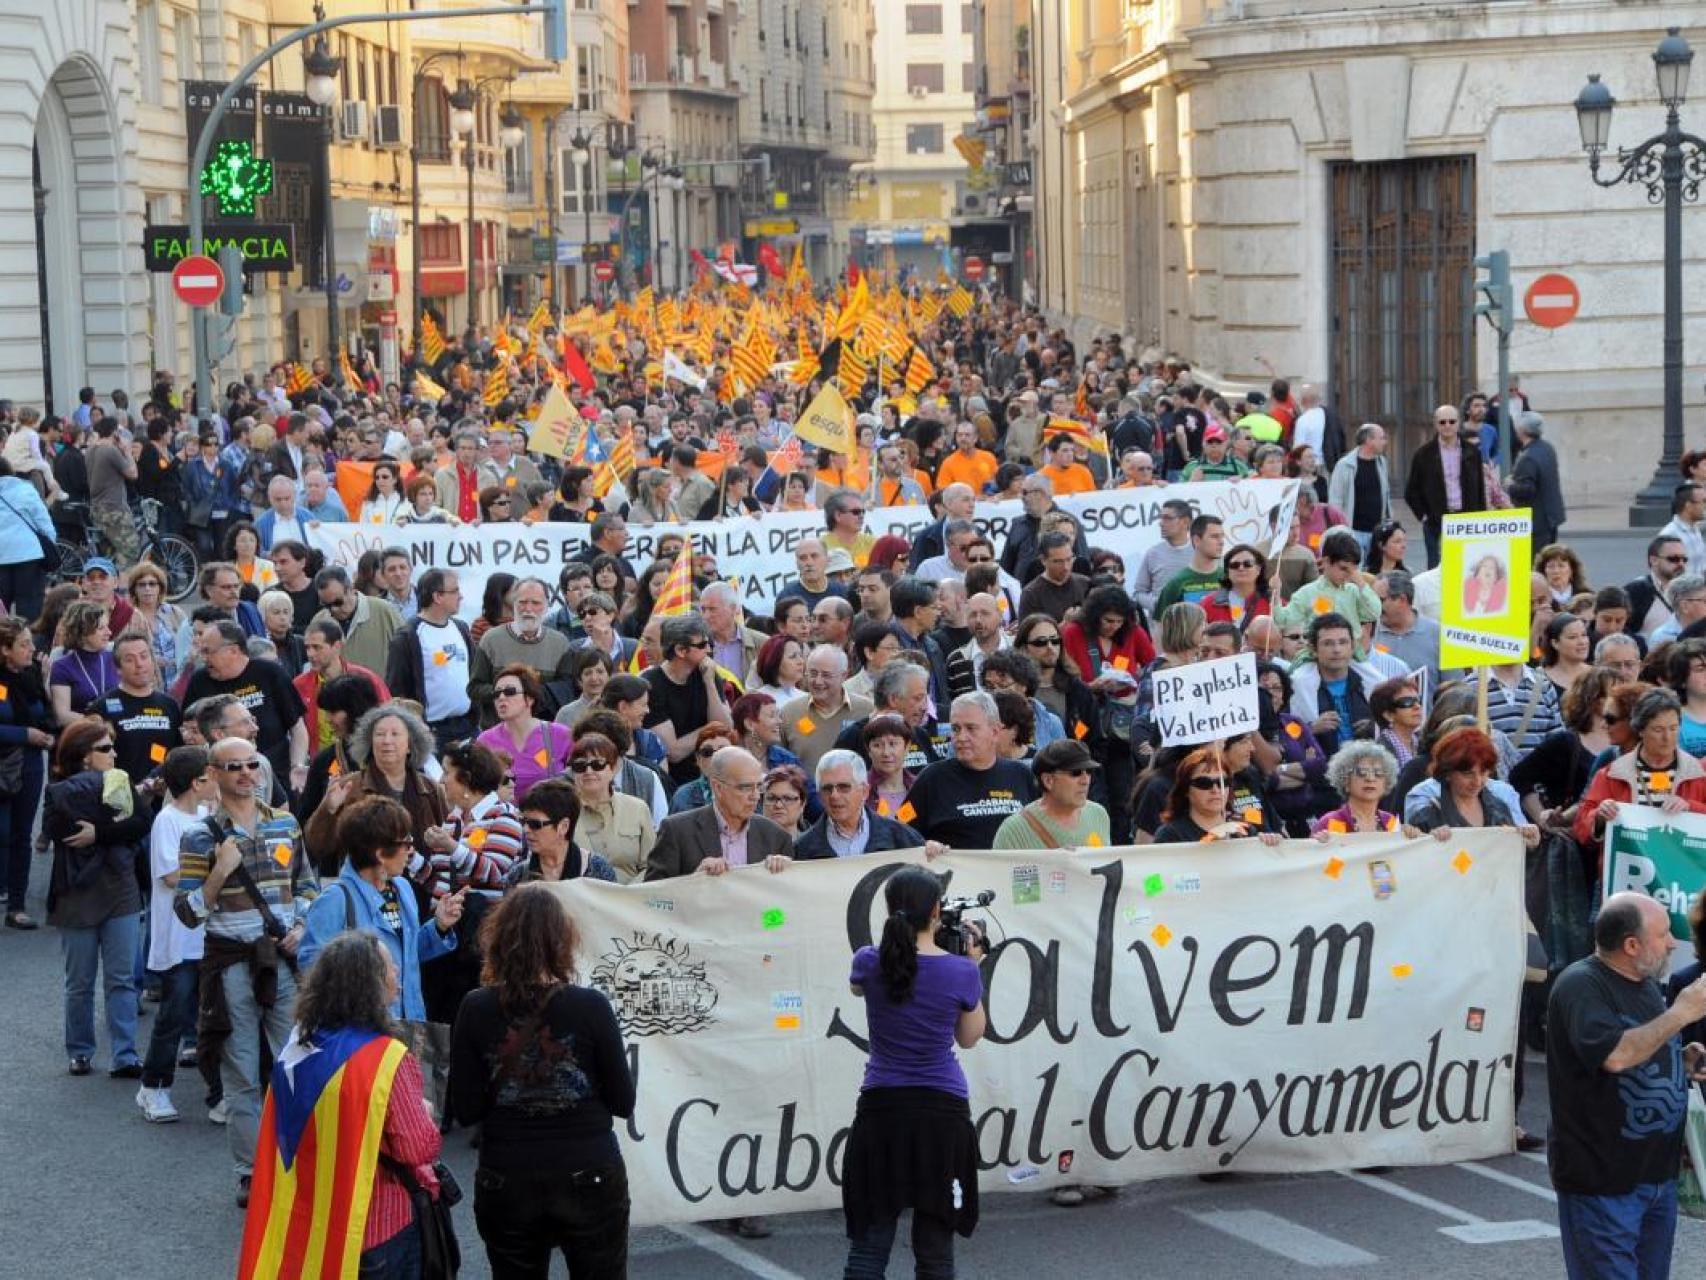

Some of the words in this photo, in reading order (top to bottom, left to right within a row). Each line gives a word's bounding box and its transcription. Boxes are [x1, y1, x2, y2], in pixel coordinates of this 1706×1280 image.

[412, 540, 434, 566] NI
[447, 540, 482, 566] UN
[493, 537, 551, 565] PAS
[726, 530, 761, 558] LA
[1446, 629, 1477, 643] FIERA
[1480, 636, 1521, 652] SUELTA
[1191, 661, 1252, 705] aplasta
